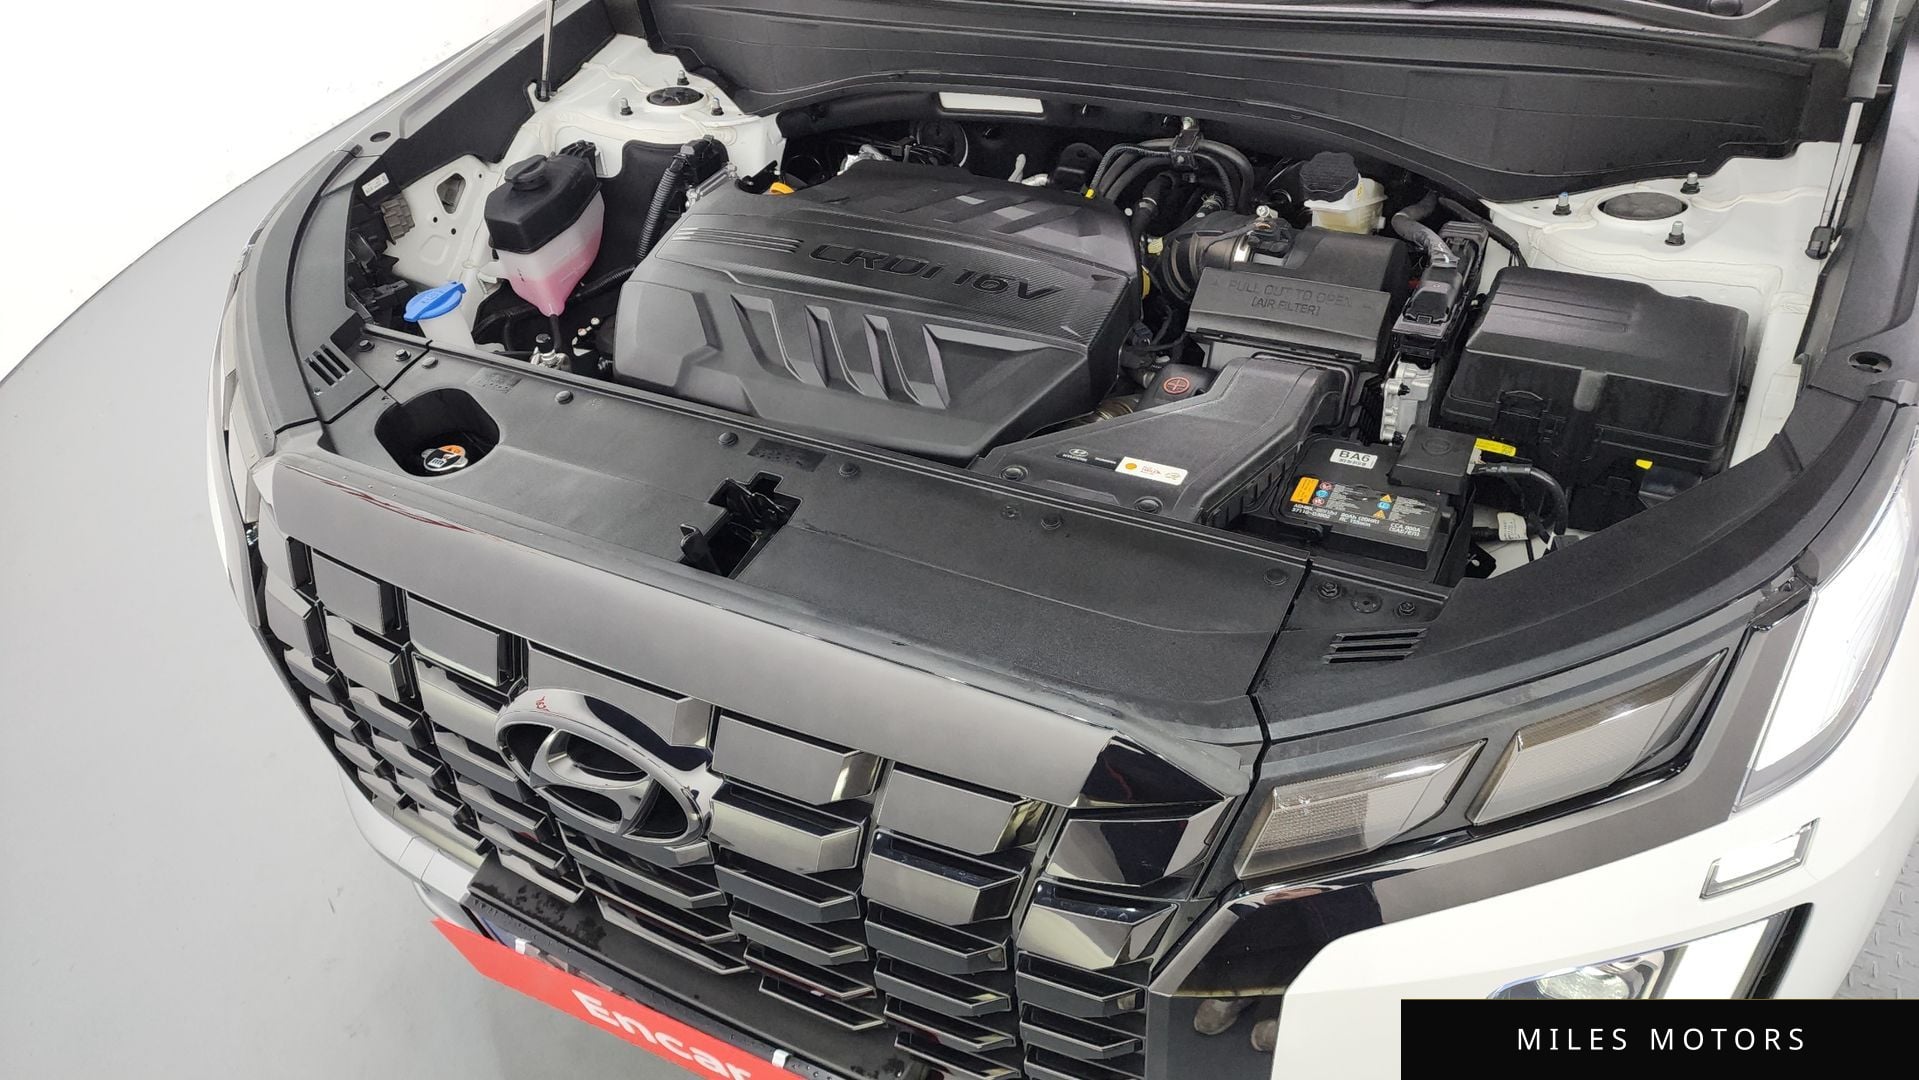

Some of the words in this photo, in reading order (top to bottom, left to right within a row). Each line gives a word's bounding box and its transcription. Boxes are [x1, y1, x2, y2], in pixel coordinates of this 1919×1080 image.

[952, 268, 1066, 300] 16V
[1228, 279, 1257, 291] PULL
[1263, 284, 1292, 297] OUT
[1295, 288, 1313, 300] TO
[1315, 292, 1352, 308] OPEN
[1339, 450, 1370, 463] BA6
[571, 988, 752, 1080] Encar
